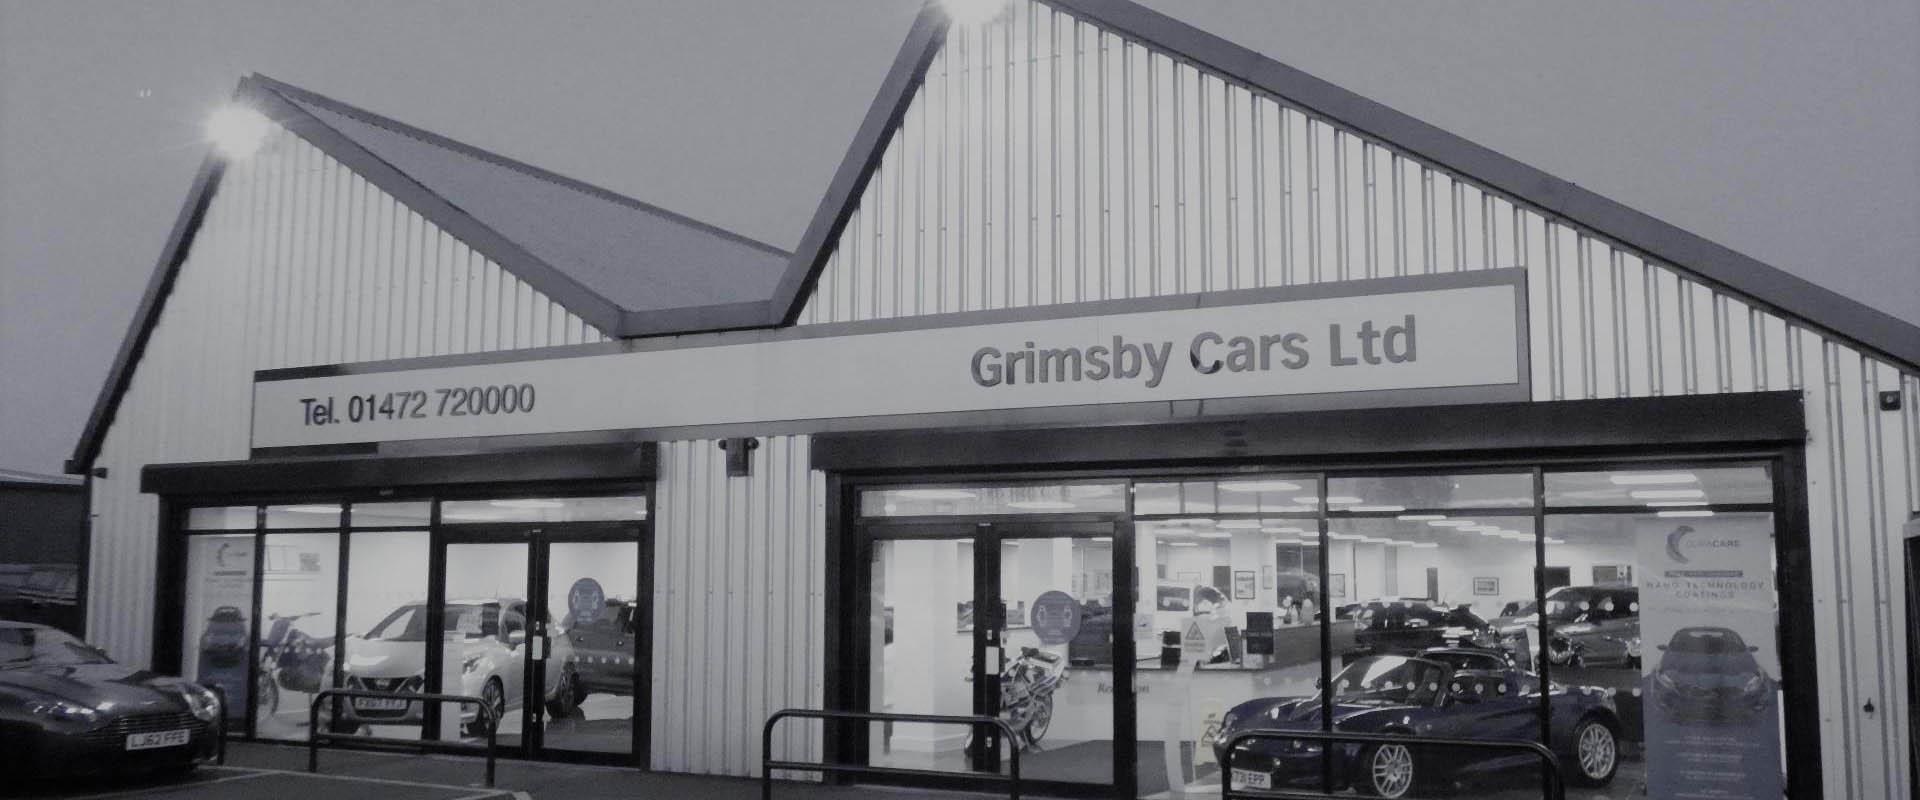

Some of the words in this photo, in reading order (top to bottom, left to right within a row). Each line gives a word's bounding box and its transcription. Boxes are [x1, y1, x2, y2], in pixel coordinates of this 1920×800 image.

[970, 334, 1173, 388] Grimsby
[1190, 330, 1310, 375] Cars
[1329, 314, 1418, 368] Ltd
[299, 396, 341, 426] Tel.
[348, 390, 428, 424] 01472
[434, 383, 536, 417] 720000
